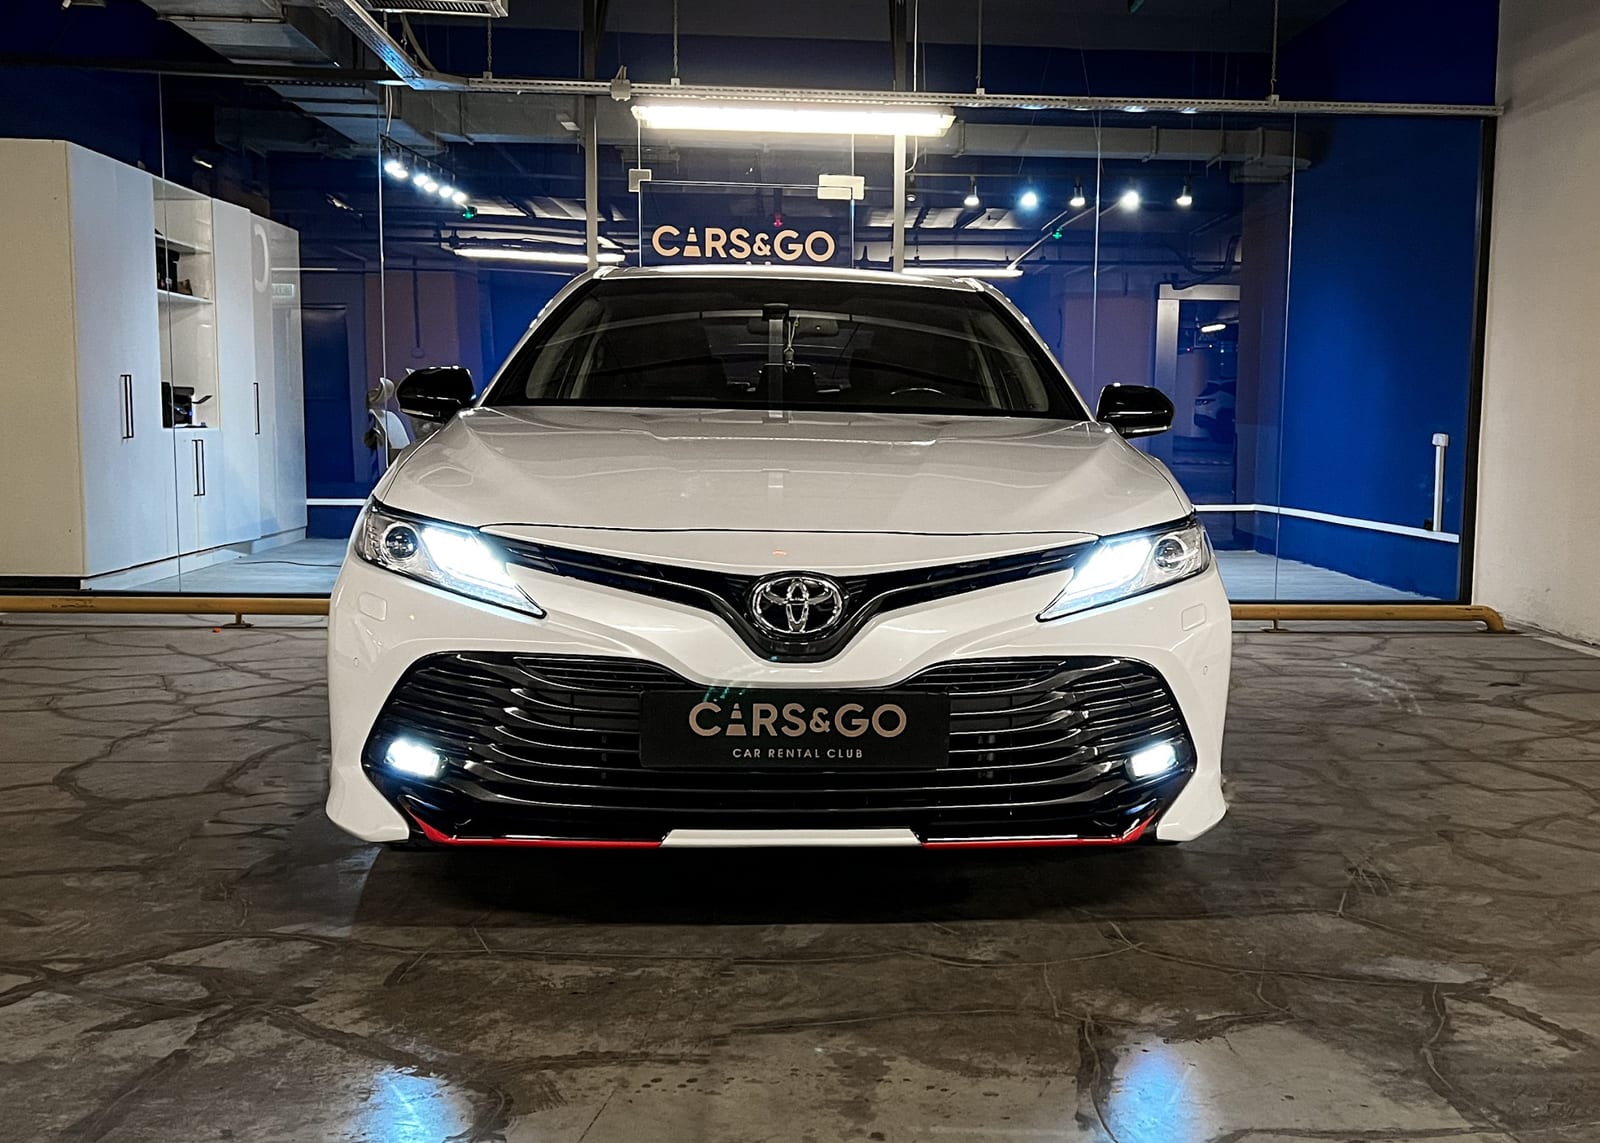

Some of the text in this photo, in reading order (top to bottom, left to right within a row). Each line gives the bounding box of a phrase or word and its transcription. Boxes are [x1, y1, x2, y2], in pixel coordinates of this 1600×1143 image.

[652, 225, 835, 262] CARS&GO
[688, 701, 907, 738] CARS&GO
[732, 748, 863, 759] CAR RENTAL CLUB
